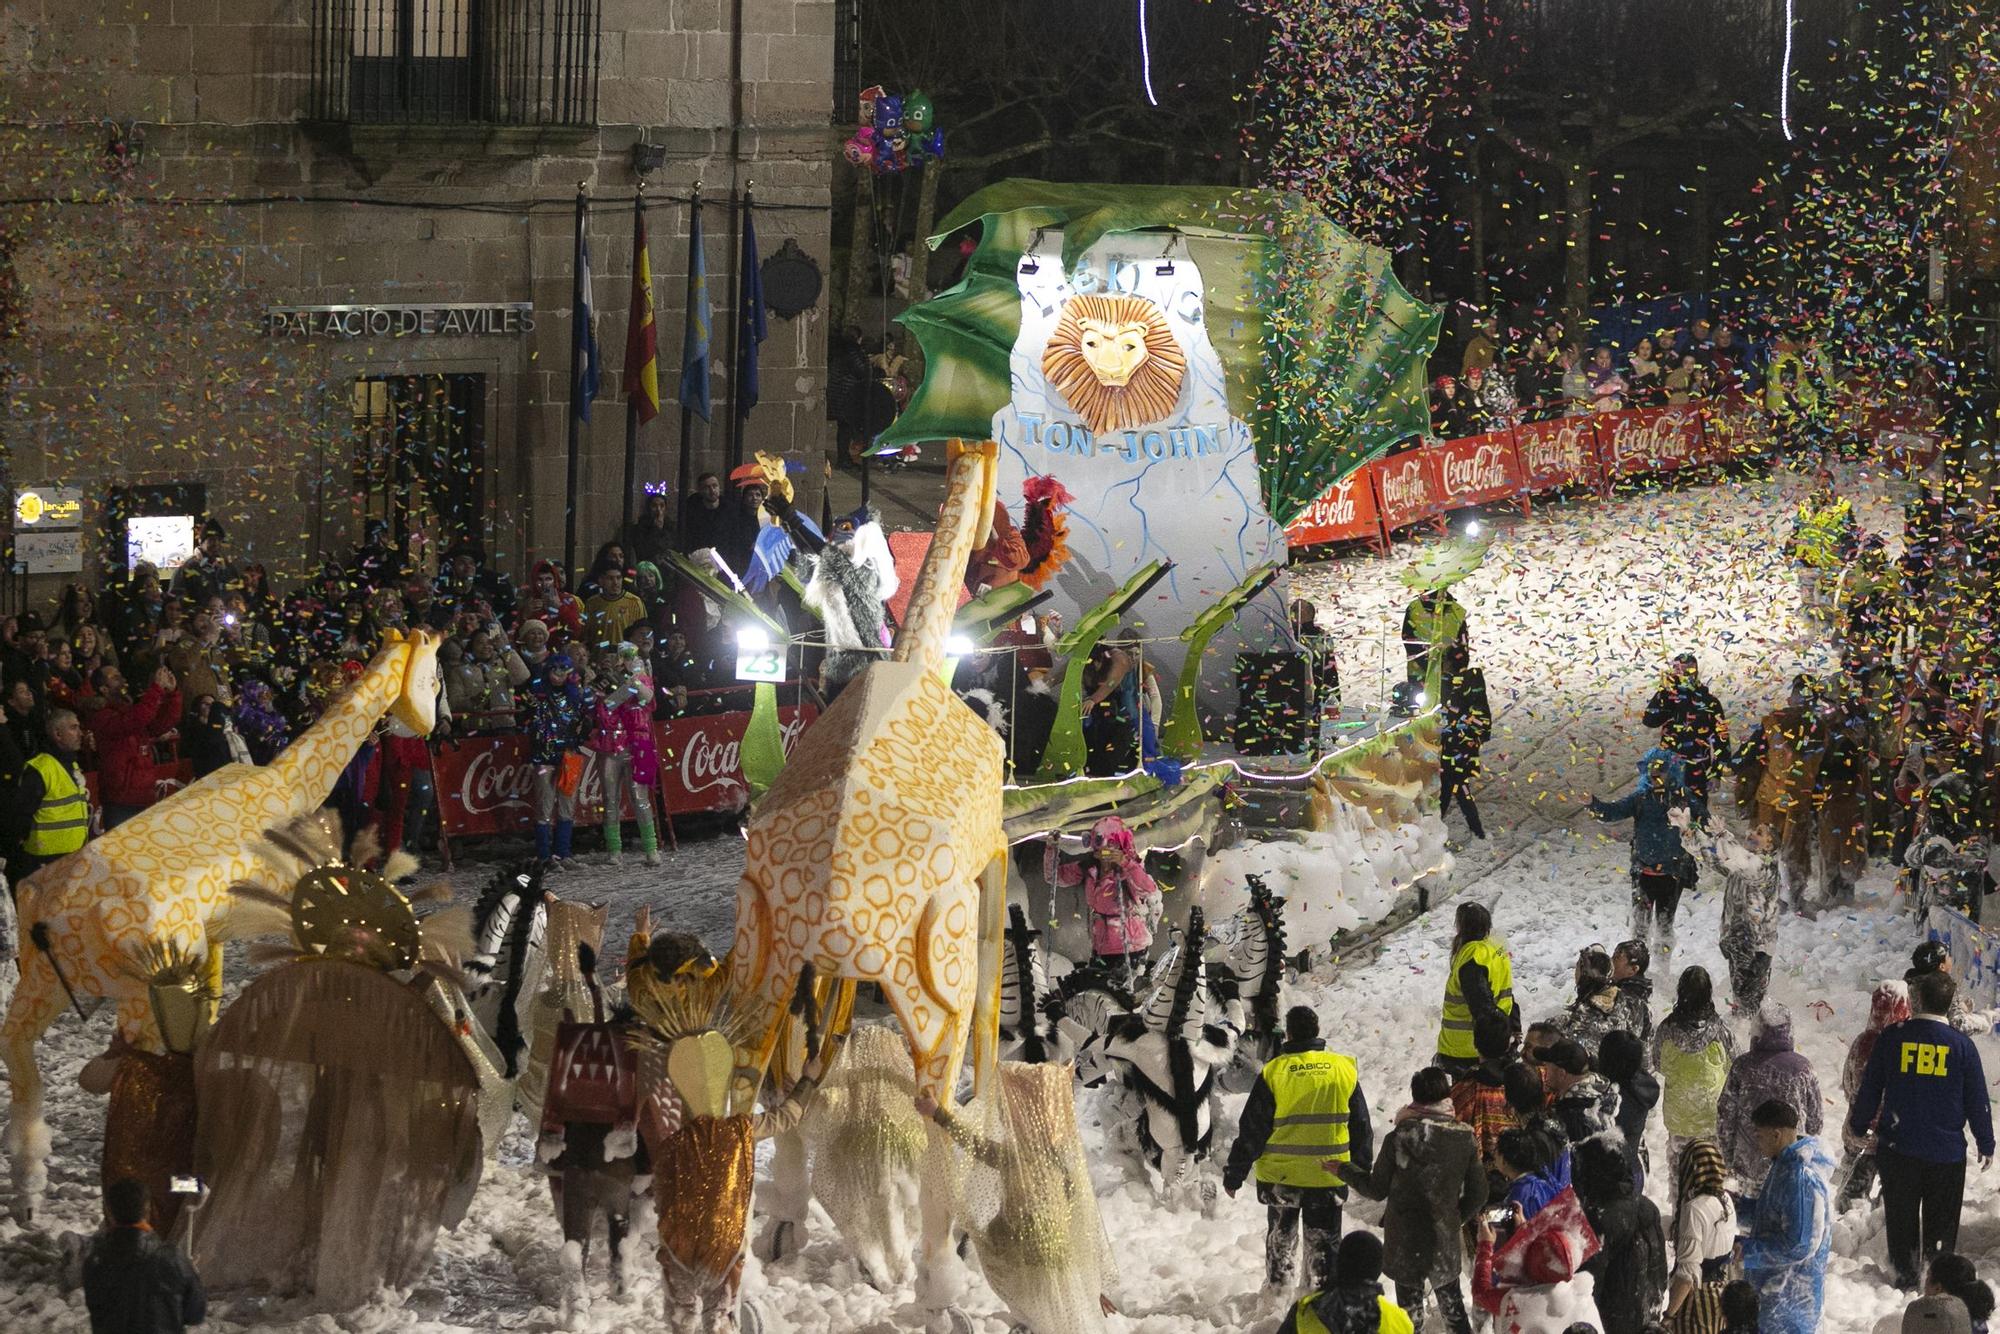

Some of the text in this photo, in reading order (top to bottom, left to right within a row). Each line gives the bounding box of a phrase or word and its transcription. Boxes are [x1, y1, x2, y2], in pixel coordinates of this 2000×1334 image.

[270, 308, 536, 337] PALACIO DE AVILES
[744, 649, 780, 675] 23
[1289, 1062, 1332, 1072] SABICO
[1901, 1042, 1950, 1077] FBI
